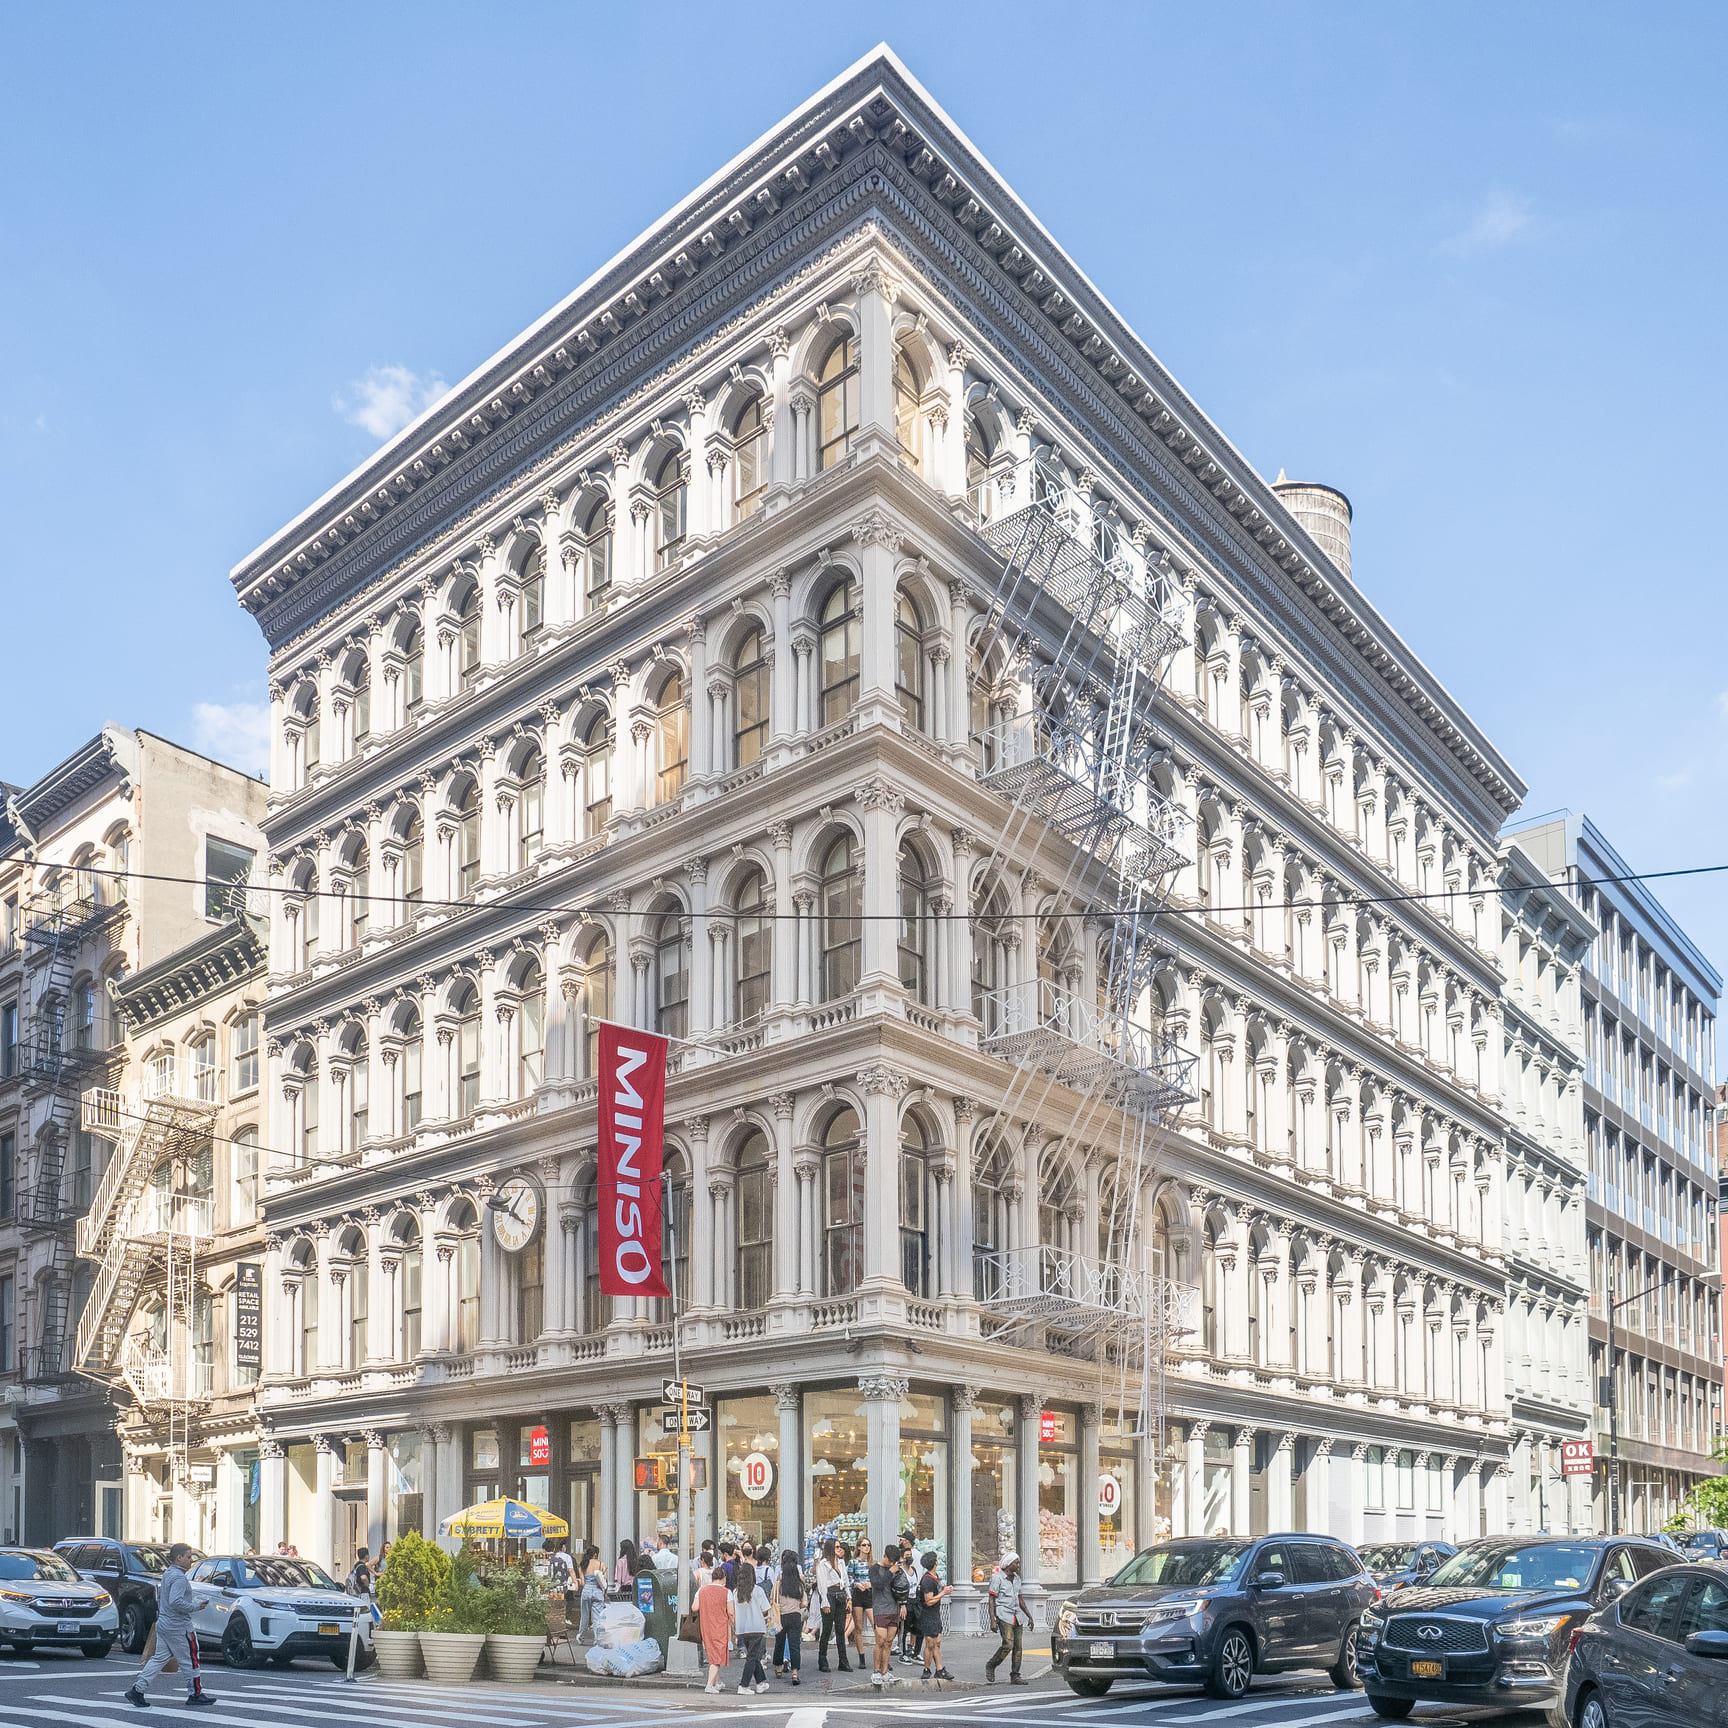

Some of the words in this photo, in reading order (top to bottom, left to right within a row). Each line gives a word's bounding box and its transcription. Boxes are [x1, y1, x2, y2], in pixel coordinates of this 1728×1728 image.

[615, 1046, 651, 1284] MINISO
[238, 1291, 260, 1299] RETAIL
[240, 1315, 258, 1326] 212
[240, 1328, 258, 1338] 529
[238, 1340, 260, 1351] 7412
[670, 1387, 681, 1397] ONE
[687, 1390, 699, 1400] WAY
[689, 1416, 703, 1425] WAY
[533, 1437, 549, 1447] MINI
[1565, 1443, 1590, 1457] OK
[746, 1462, 765, 1486] 10
